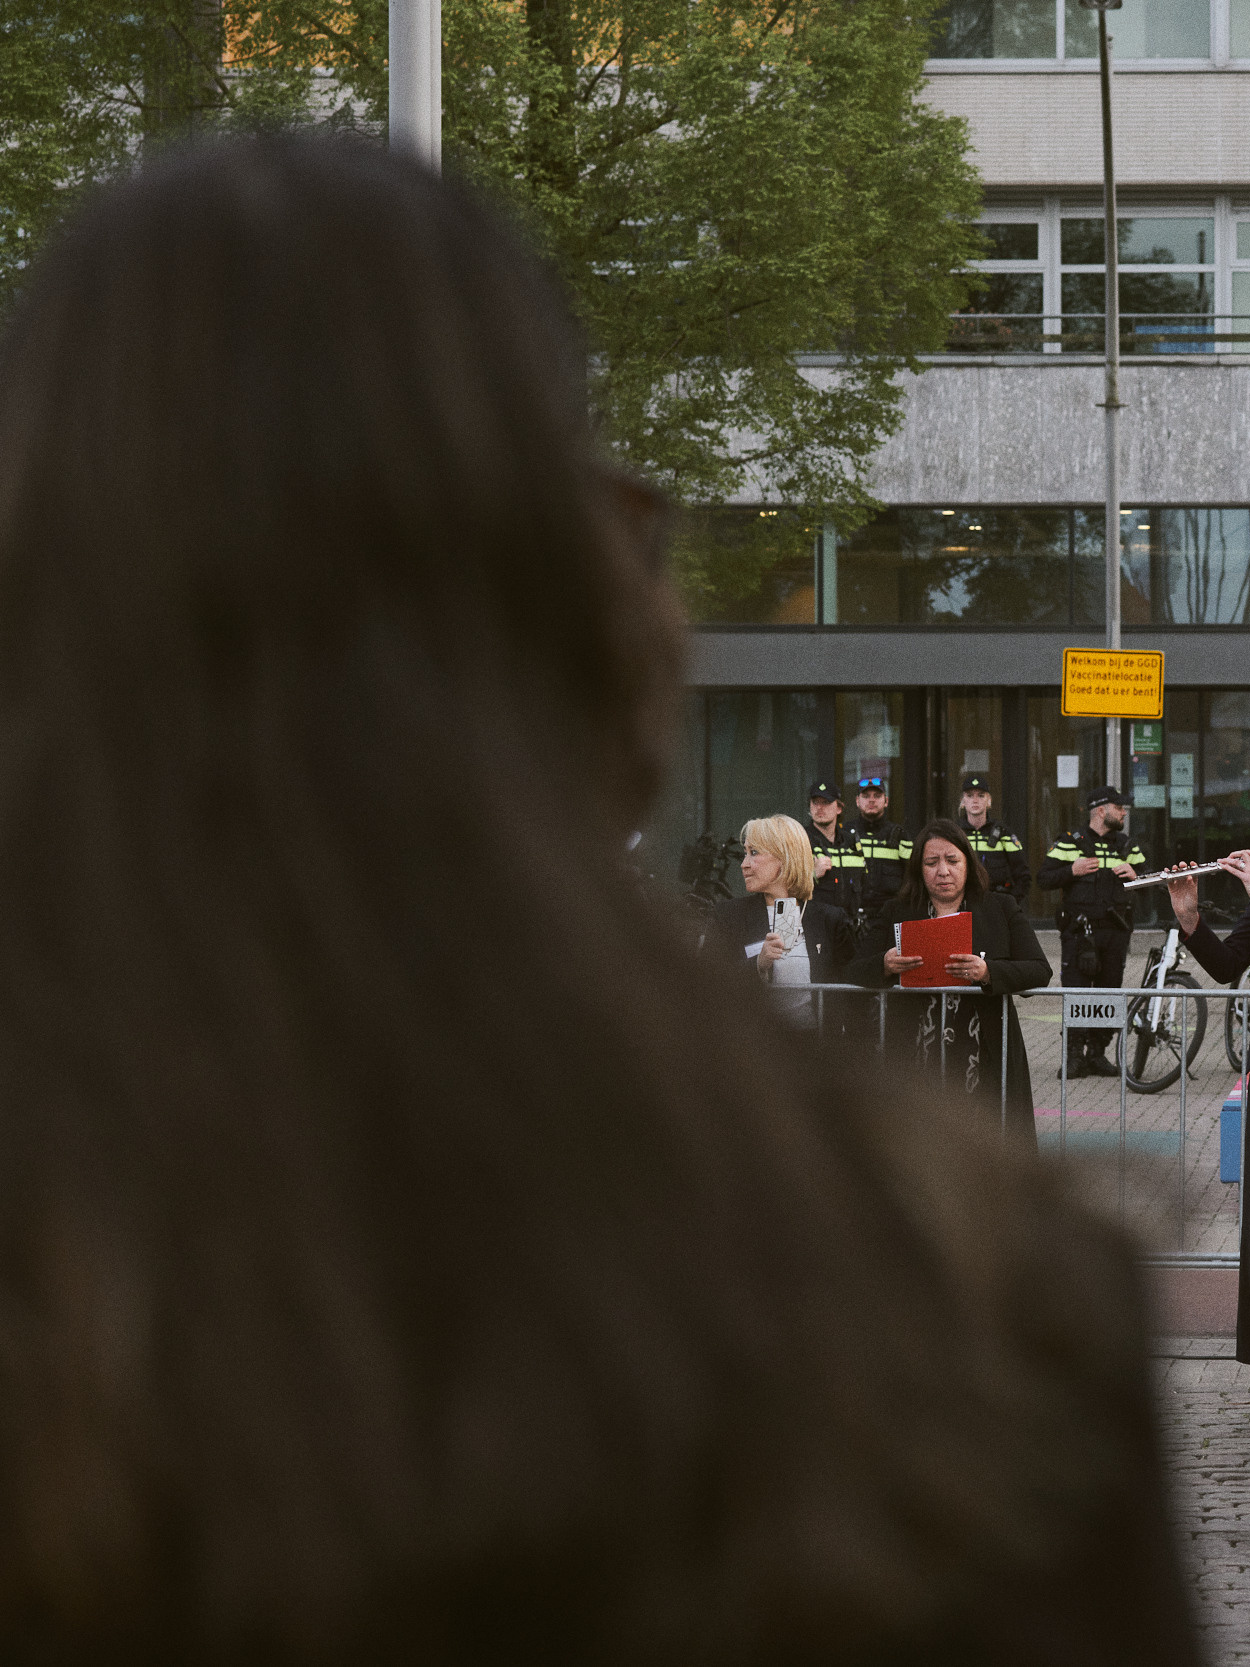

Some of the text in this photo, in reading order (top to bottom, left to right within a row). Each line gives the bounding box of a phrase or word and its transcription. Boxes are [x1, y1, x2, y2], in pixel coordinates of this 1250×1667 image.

[1070, 656, 1158, 669] Welkom bij de GGD
[1070, 670, 1152, 681] Vaccinatielocatie
[1070, 684, 1092, 694] Goed
[1095, 686, 1110, 695] dat
[1133, 687, 1157, 696] bent!
[1070, 1004, 1115, 1018] BUKO
